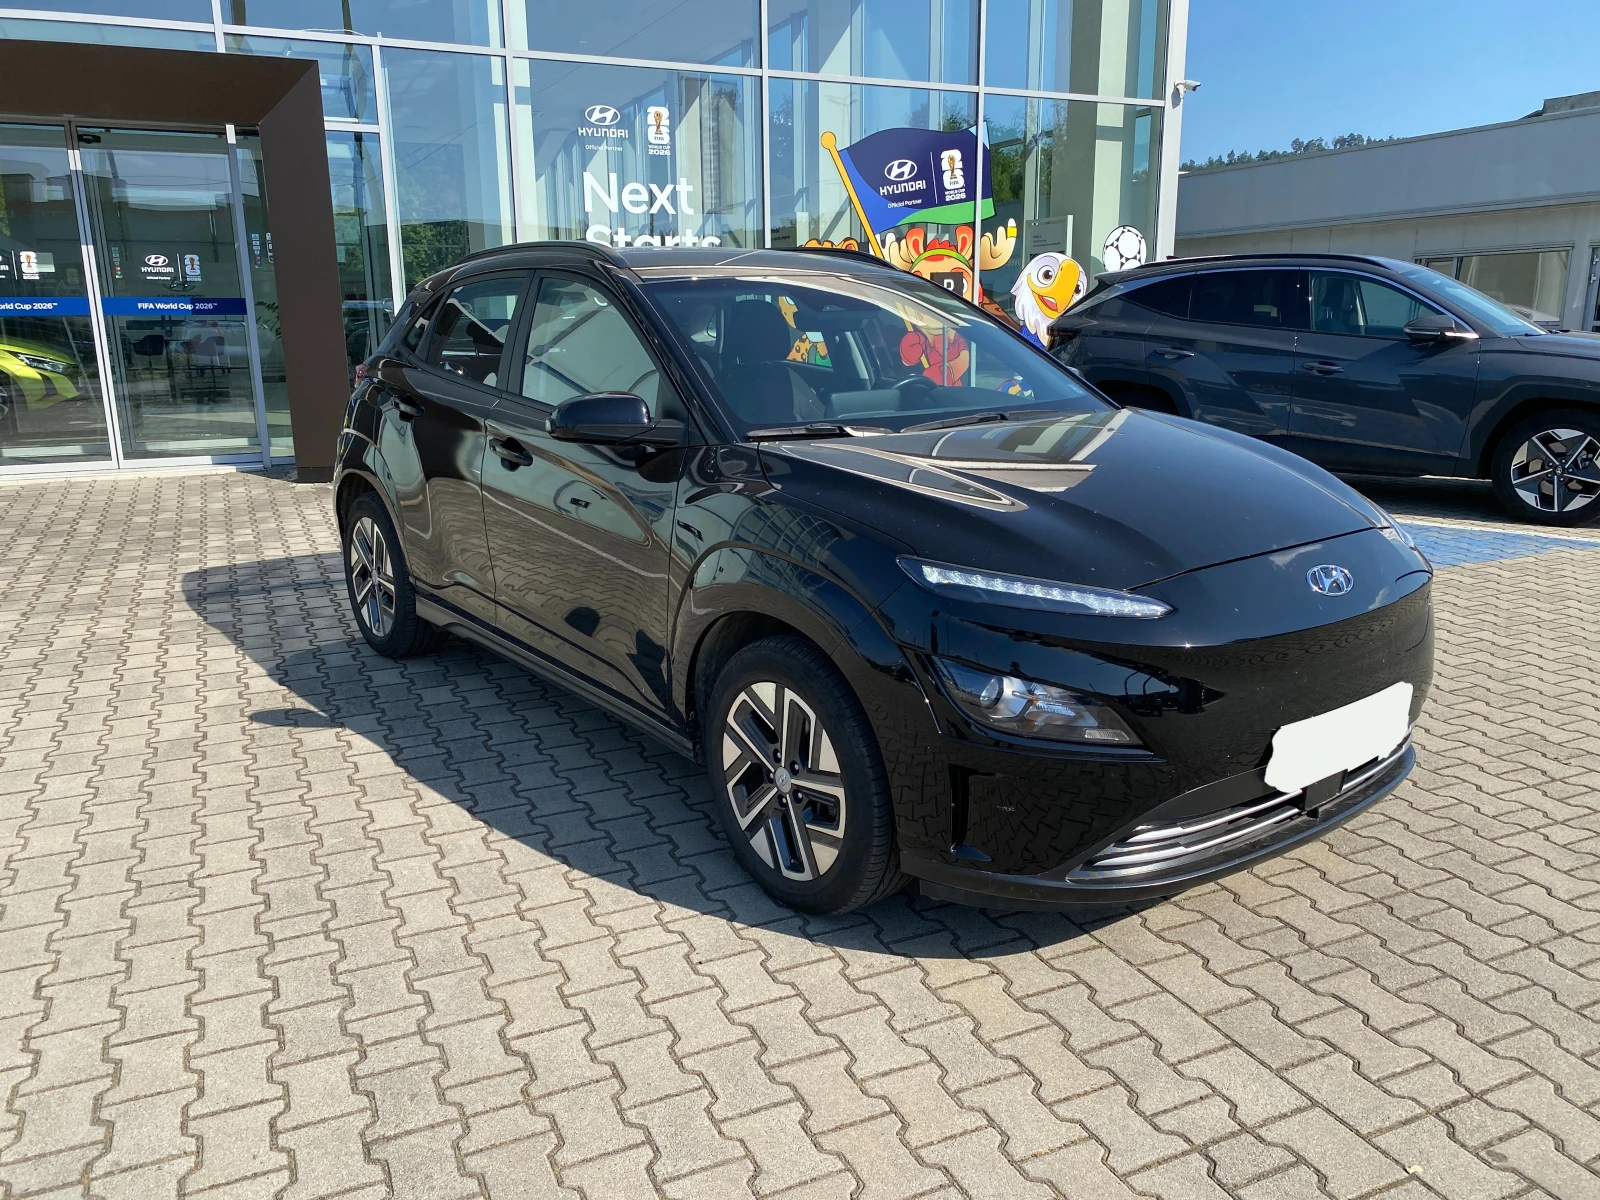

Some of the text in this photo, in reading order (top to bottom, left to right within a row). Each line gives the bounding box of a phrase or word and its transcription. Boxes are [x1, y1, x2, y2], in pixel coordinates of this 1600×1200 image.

[578, 127, 629, 138] HYUNDAI
[880, 180, 926, 196] HYUNDAI
[583, 171, 694, 215] Next
[945, 193, 966, 201] 2026
[887, 201, 905, 209] Official
[0, 302, 14, 310] orld
[15, 302, 32, 311] Cup
[137, 302, 154, 310] FIFA
[155, 302, 178, 310] World
[179, 302, 194, 311] Cup
